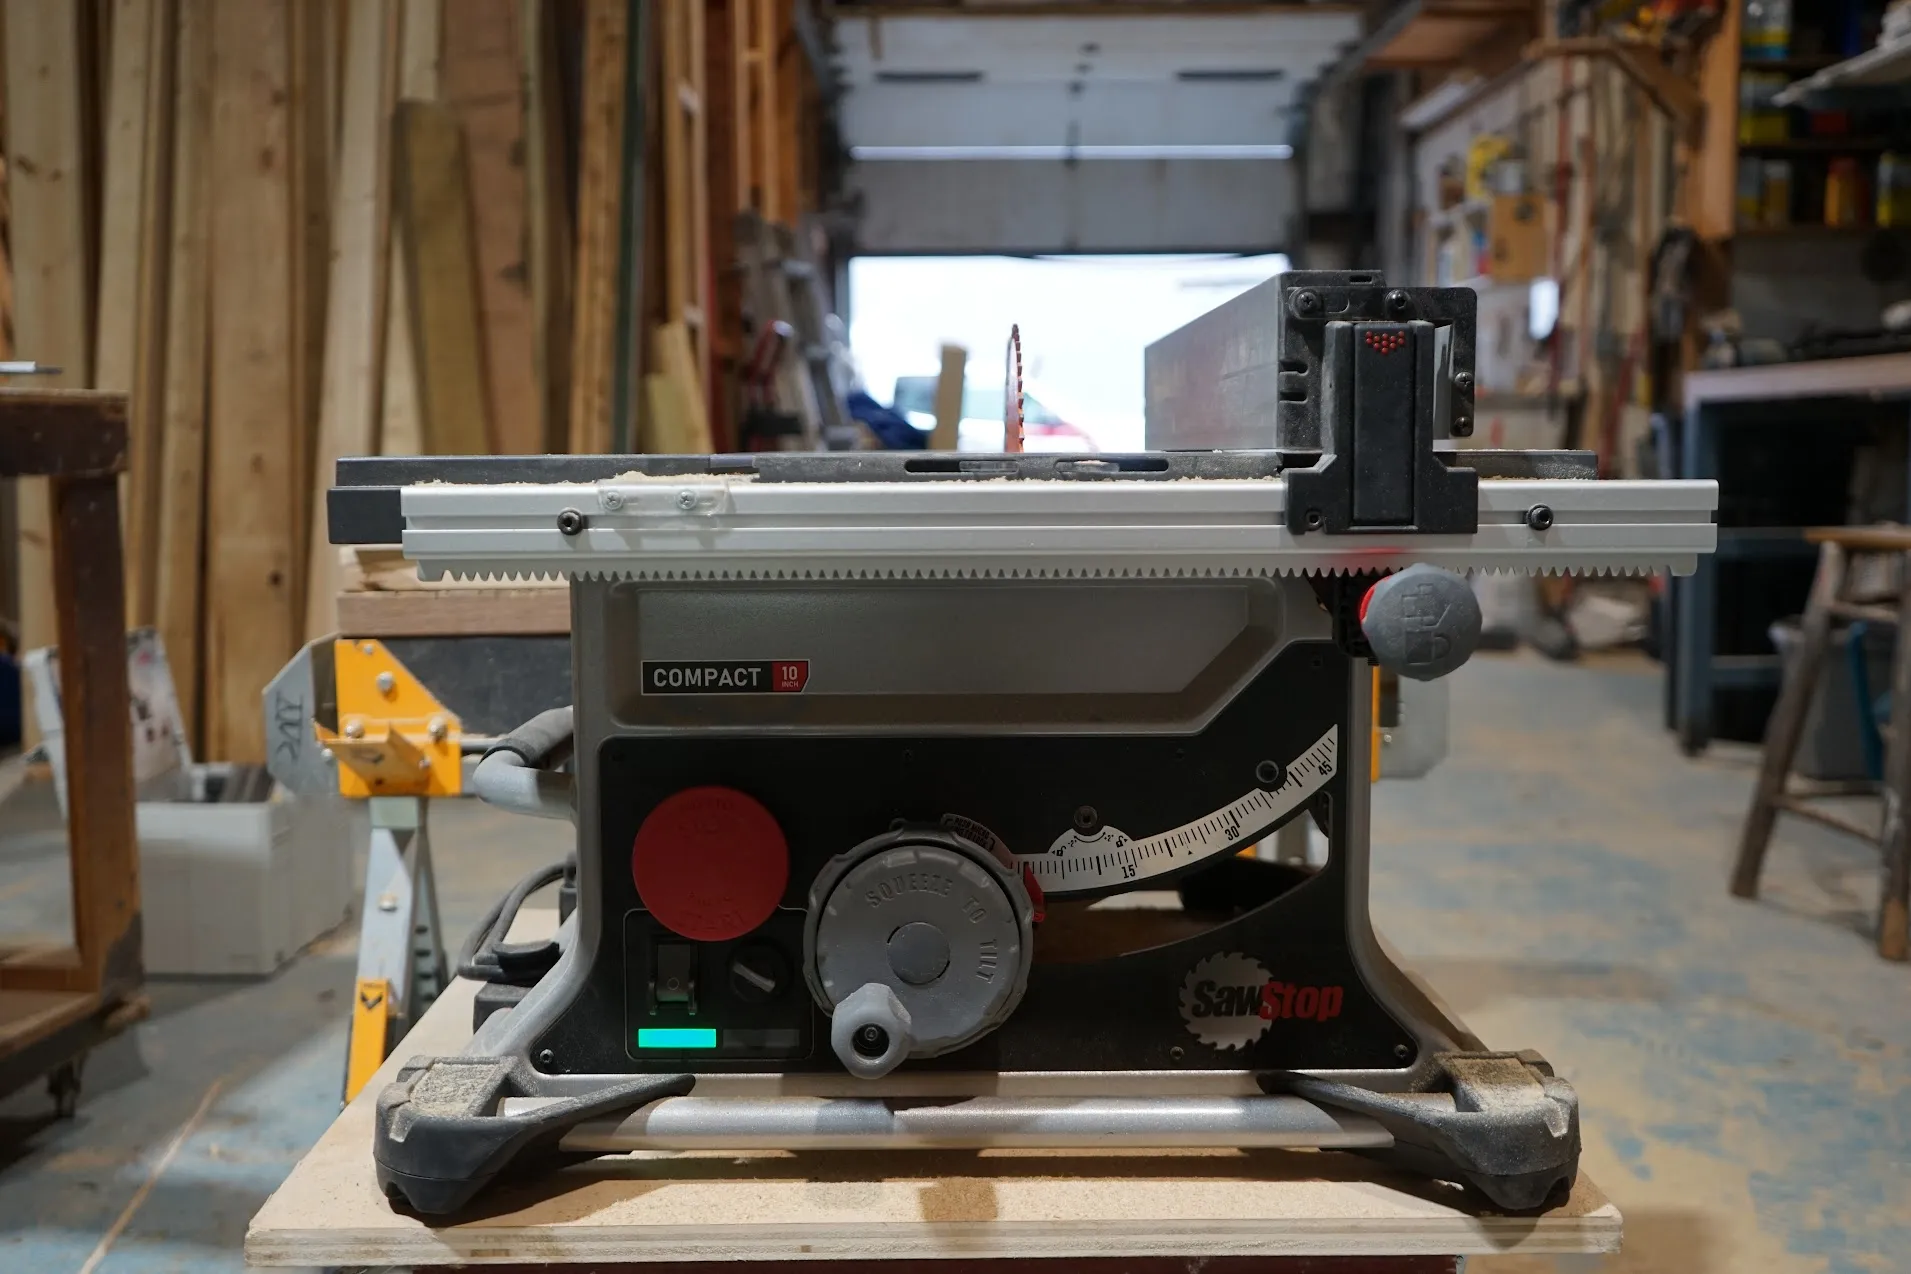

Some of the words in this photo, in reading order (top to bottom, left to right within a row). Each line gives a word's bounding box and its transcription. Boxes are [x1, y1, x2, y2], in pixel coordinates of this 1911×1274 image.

[653, 667, 762, 687] COMPACT
[781, 666, 798, 681] 10
[1318, 761, 1333, 776] 45
[1224, 826, 1240, 842] 30
[1120, 864, 1137, 879] 15
[864, 873, 954, 909] SQUEEZE
[960, 896, 989, 924] TO
[974, 938, 999, 984] TILT
[1192, 979, 1344, 1022] SawStop
